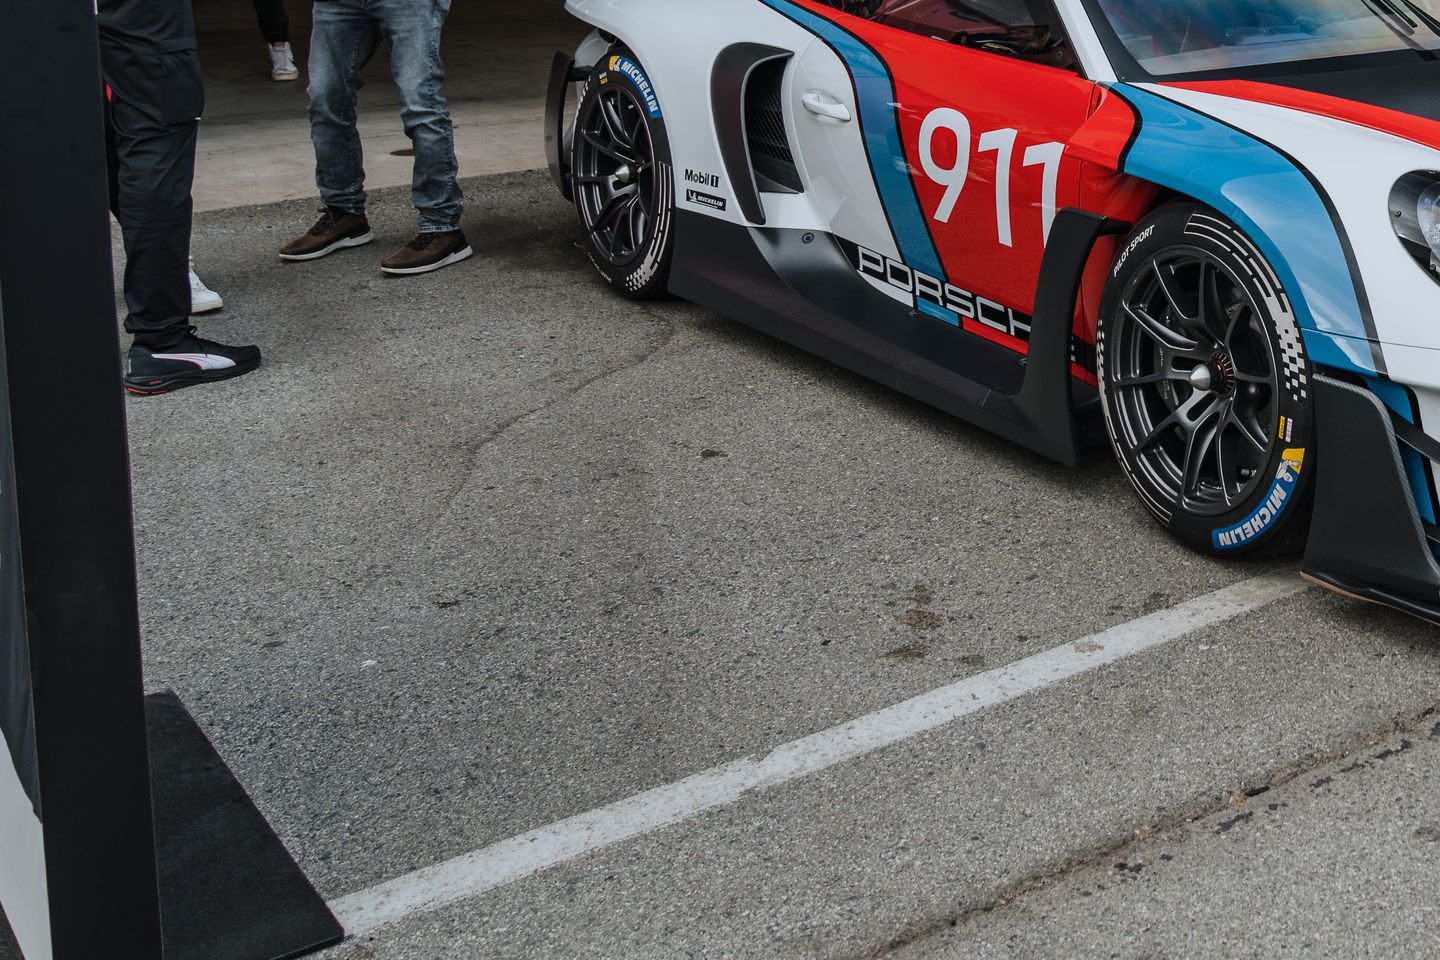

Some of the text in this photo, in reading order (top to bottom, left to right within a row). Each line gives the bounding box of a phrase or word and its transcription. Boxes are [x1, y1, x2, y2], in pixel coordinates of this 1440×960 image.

[620, 60, 658, 114] MICHELIN
[684, 168, 710, 186] Mobil
[698, 195, 724, 207] MICHELIN
[918, 107, 1065, 250] 911
[1113, 224, 1155, 277] PILOT SPORT
[858, 245, 1032, 336] PORSCH
[1218, 483, 1287, 546] MICHELIN
